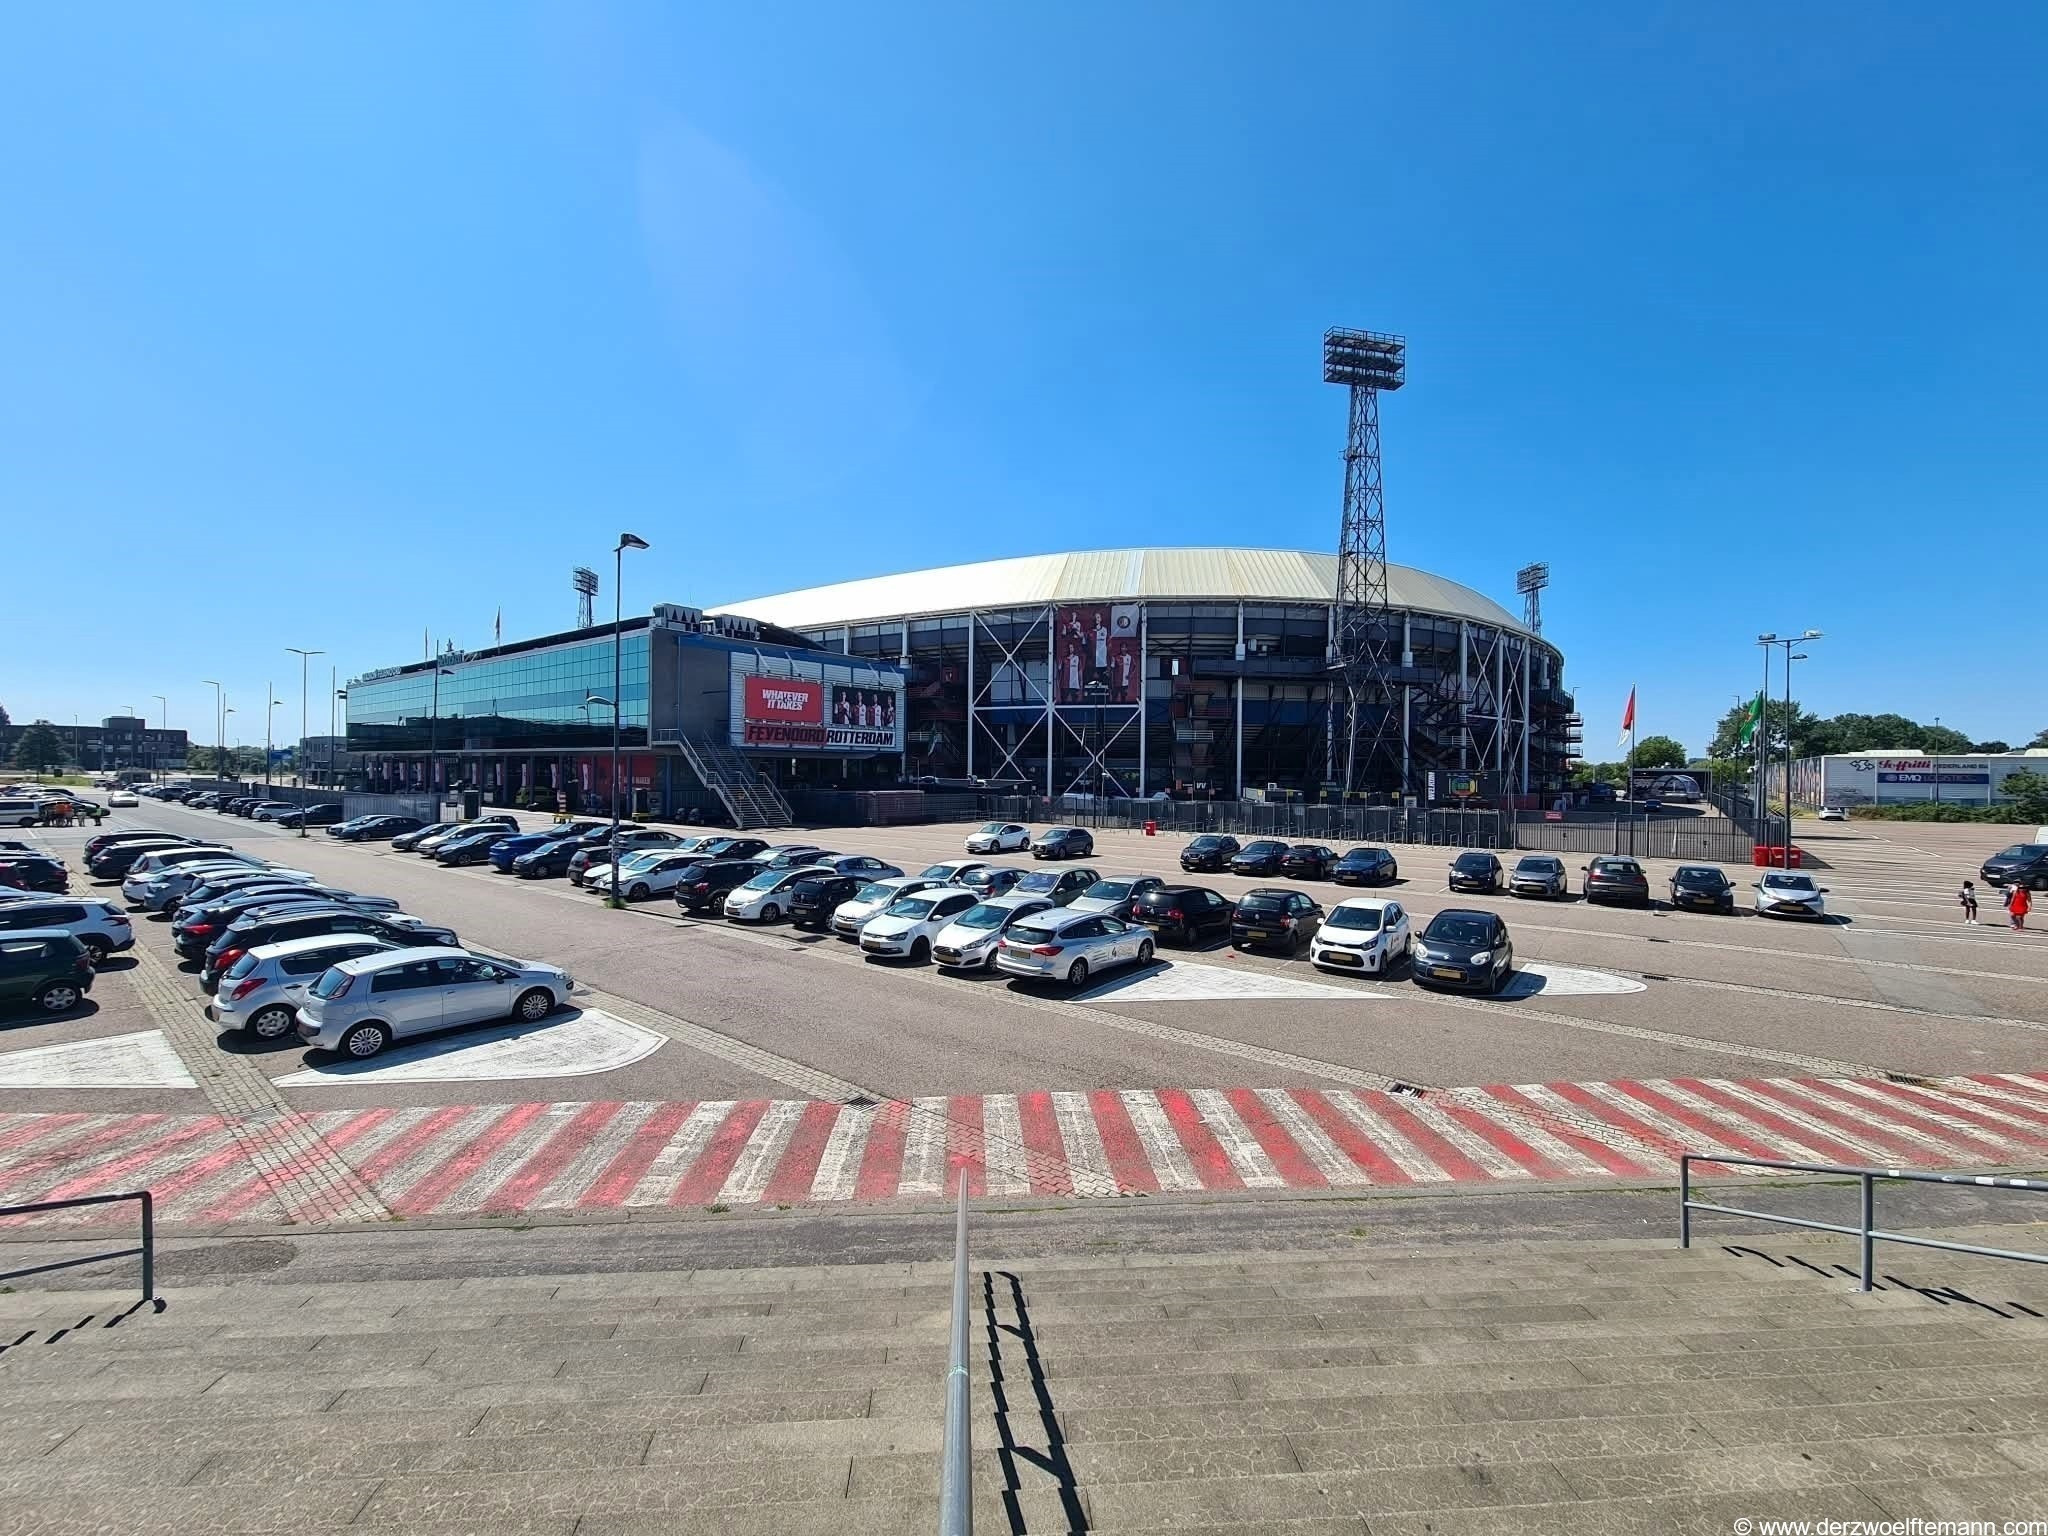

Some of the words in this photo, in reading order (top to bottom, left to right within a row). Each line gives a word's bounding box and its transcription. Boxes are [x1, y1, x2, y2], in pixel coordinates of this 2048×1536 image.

[762, 688, 808, 702] WHATEVER
[767, 700, 776, 709] IT
[776, 700, 804, 711] TAKES
[747, 725, 826, 744] FEYENOORD
[827, 729, 894, 746] ROTTERDAM
